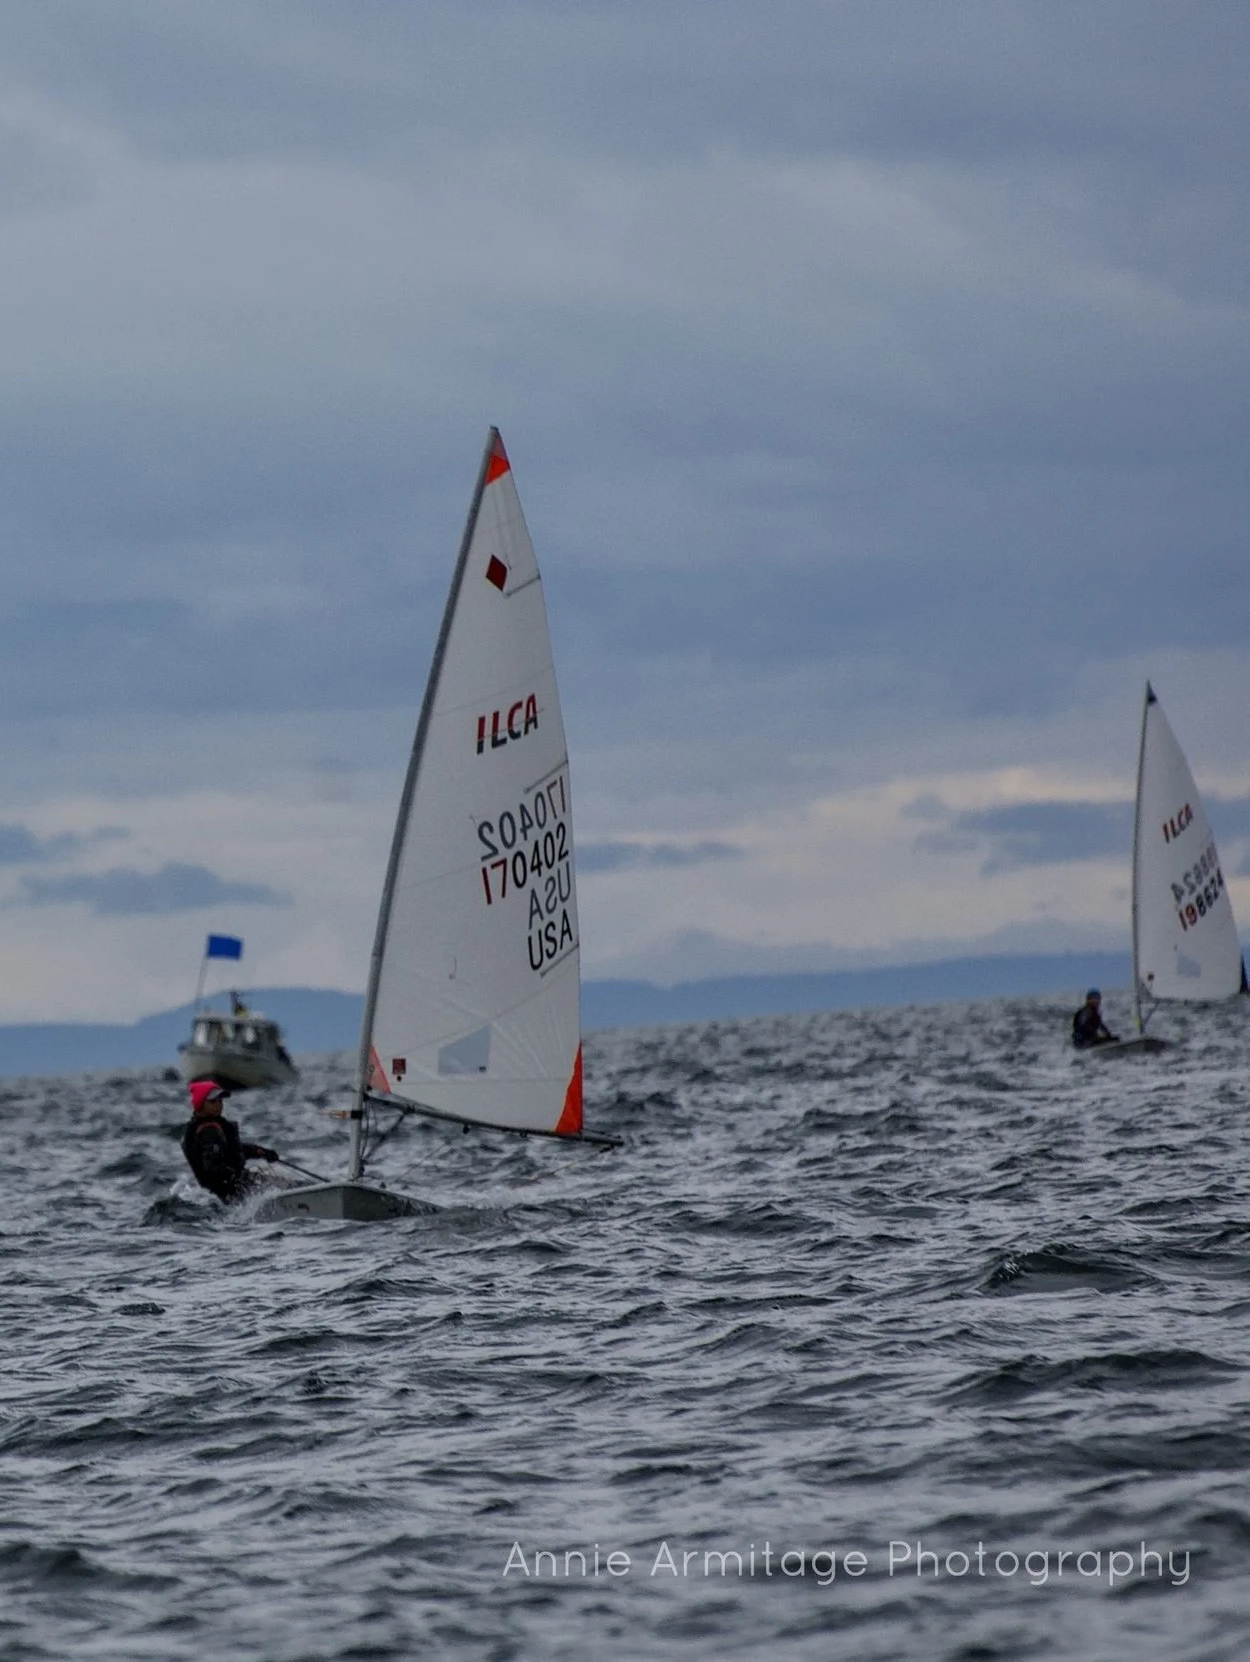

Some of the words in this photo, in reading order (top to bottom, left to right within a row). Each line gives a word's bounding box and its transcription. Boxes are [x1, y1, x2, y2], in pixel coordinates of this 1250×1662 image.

[477, 694, 538, 754] ILCA
[1162, 803, 1194, 844] ILCA
[482, 821, 570, 904] 170402
[528, 909, 573, 972] USA
